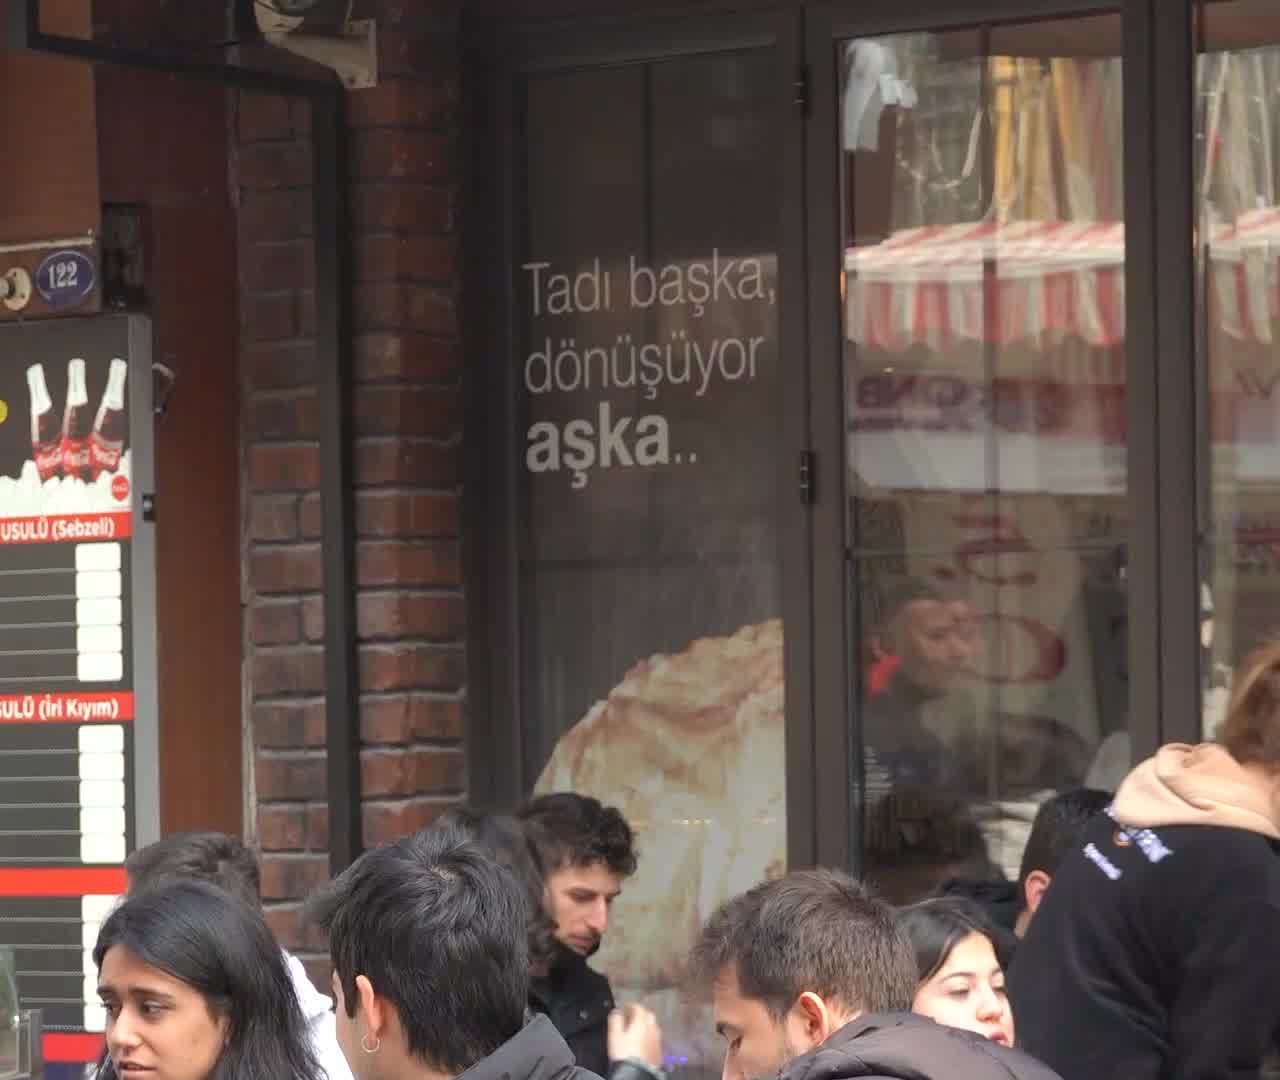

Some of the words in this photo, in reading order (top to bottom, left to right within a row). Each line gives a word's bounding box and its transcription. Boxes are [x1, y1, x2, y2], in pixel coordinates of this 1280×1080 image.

[49, 261, 78, 289] 122
[521, 256, 611, 317] Tadı
[629, 247, 776, 318] başka,
[524, 329, 765, 400] dönüşüyor
[526, 401, 697, 489] aşka..
[1, 517, 49, 542] USULÜ
[51, 518, 115, 539] (Sebzeli)
[38, 694, 63, 721] (İri
[66, 698, 120, 719] Kıyım)
